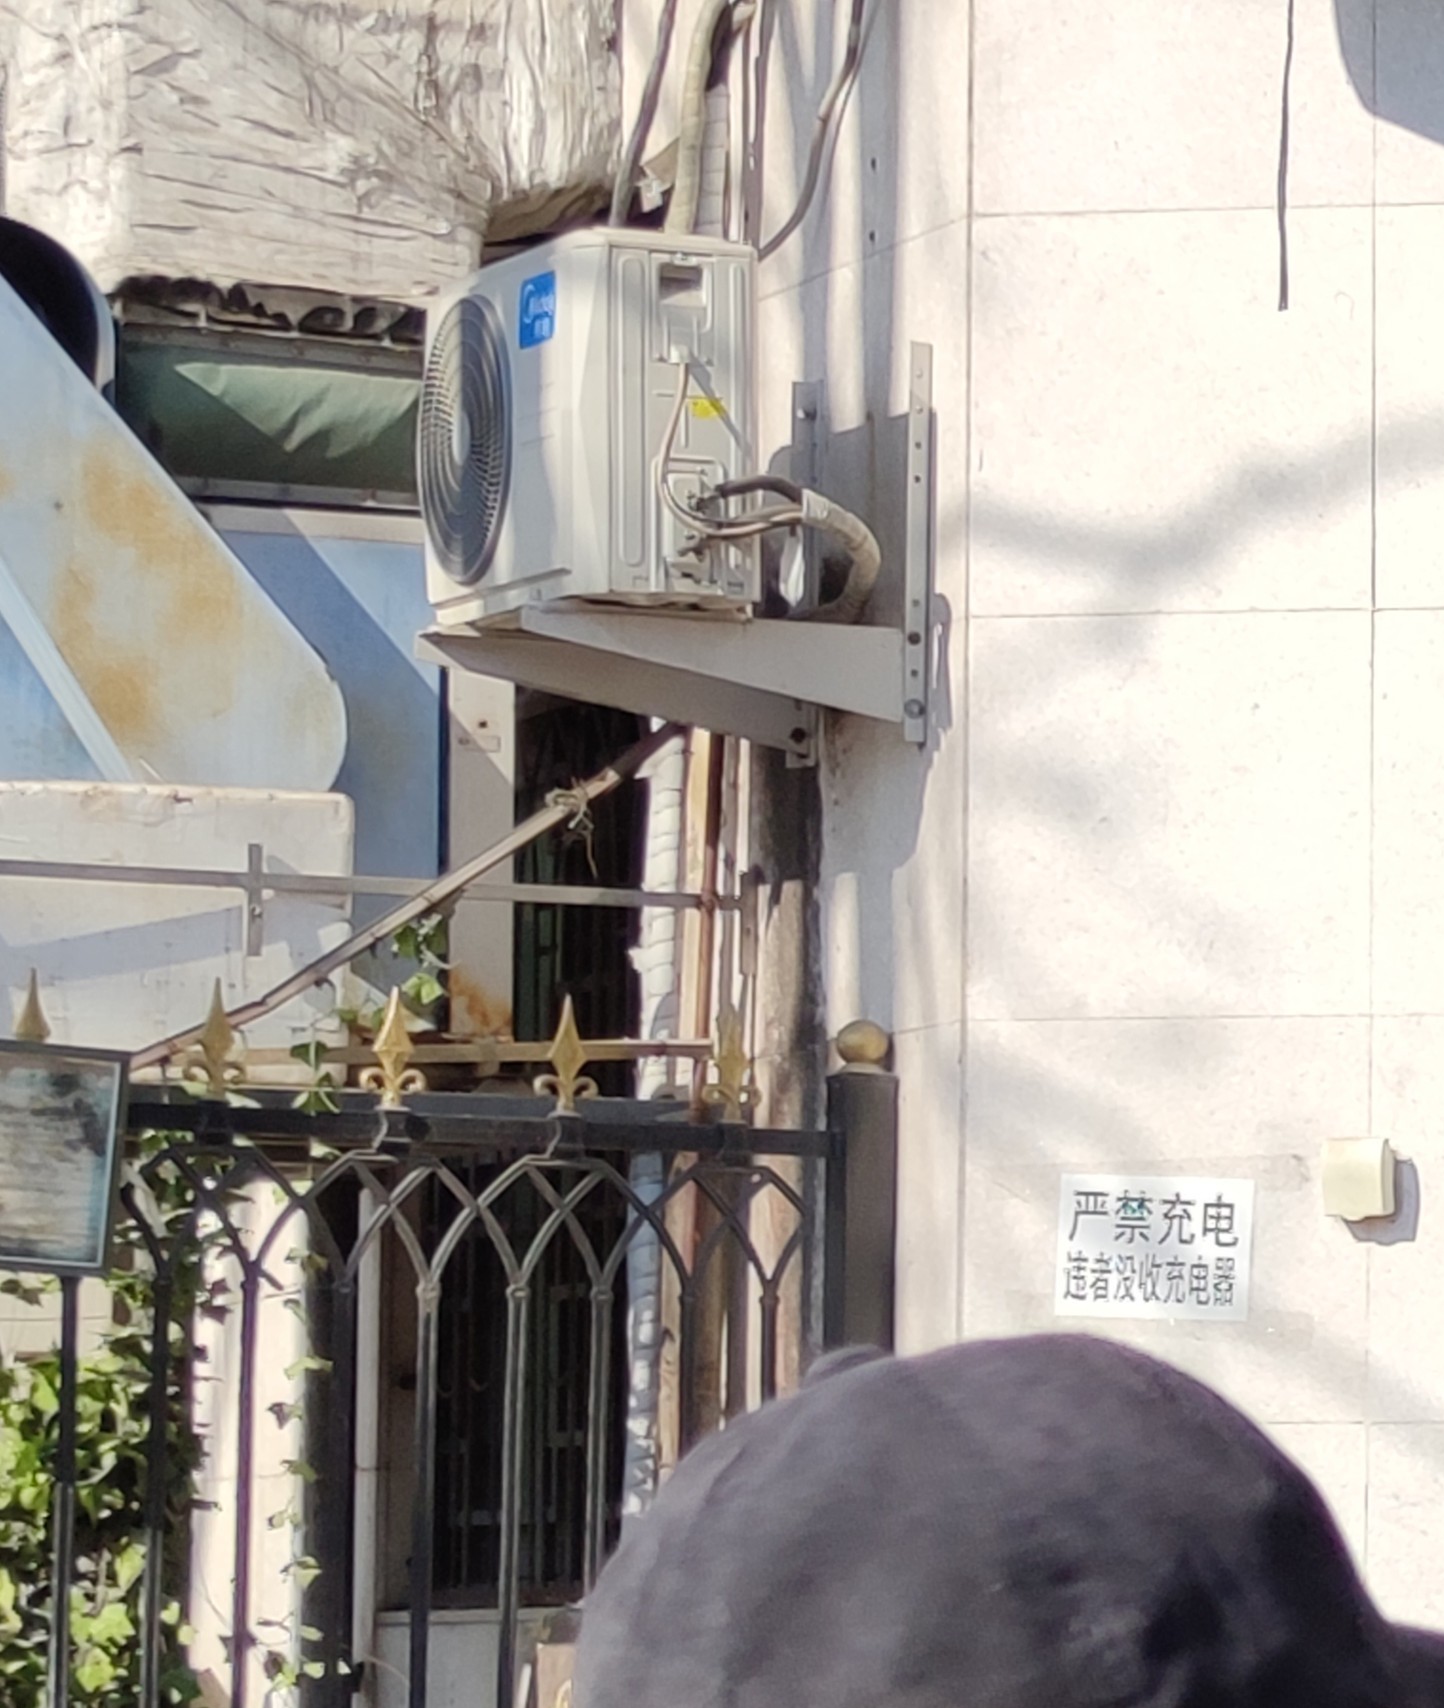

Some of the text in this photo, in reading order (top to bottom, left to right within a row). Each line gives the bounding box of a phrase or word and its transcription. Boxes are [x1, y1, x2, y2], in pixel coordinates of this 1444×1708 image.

[1068, 1189, 1240, 1248] 严禁充电
[1063, 1250, 1236, 1307] 违者没收充电器
